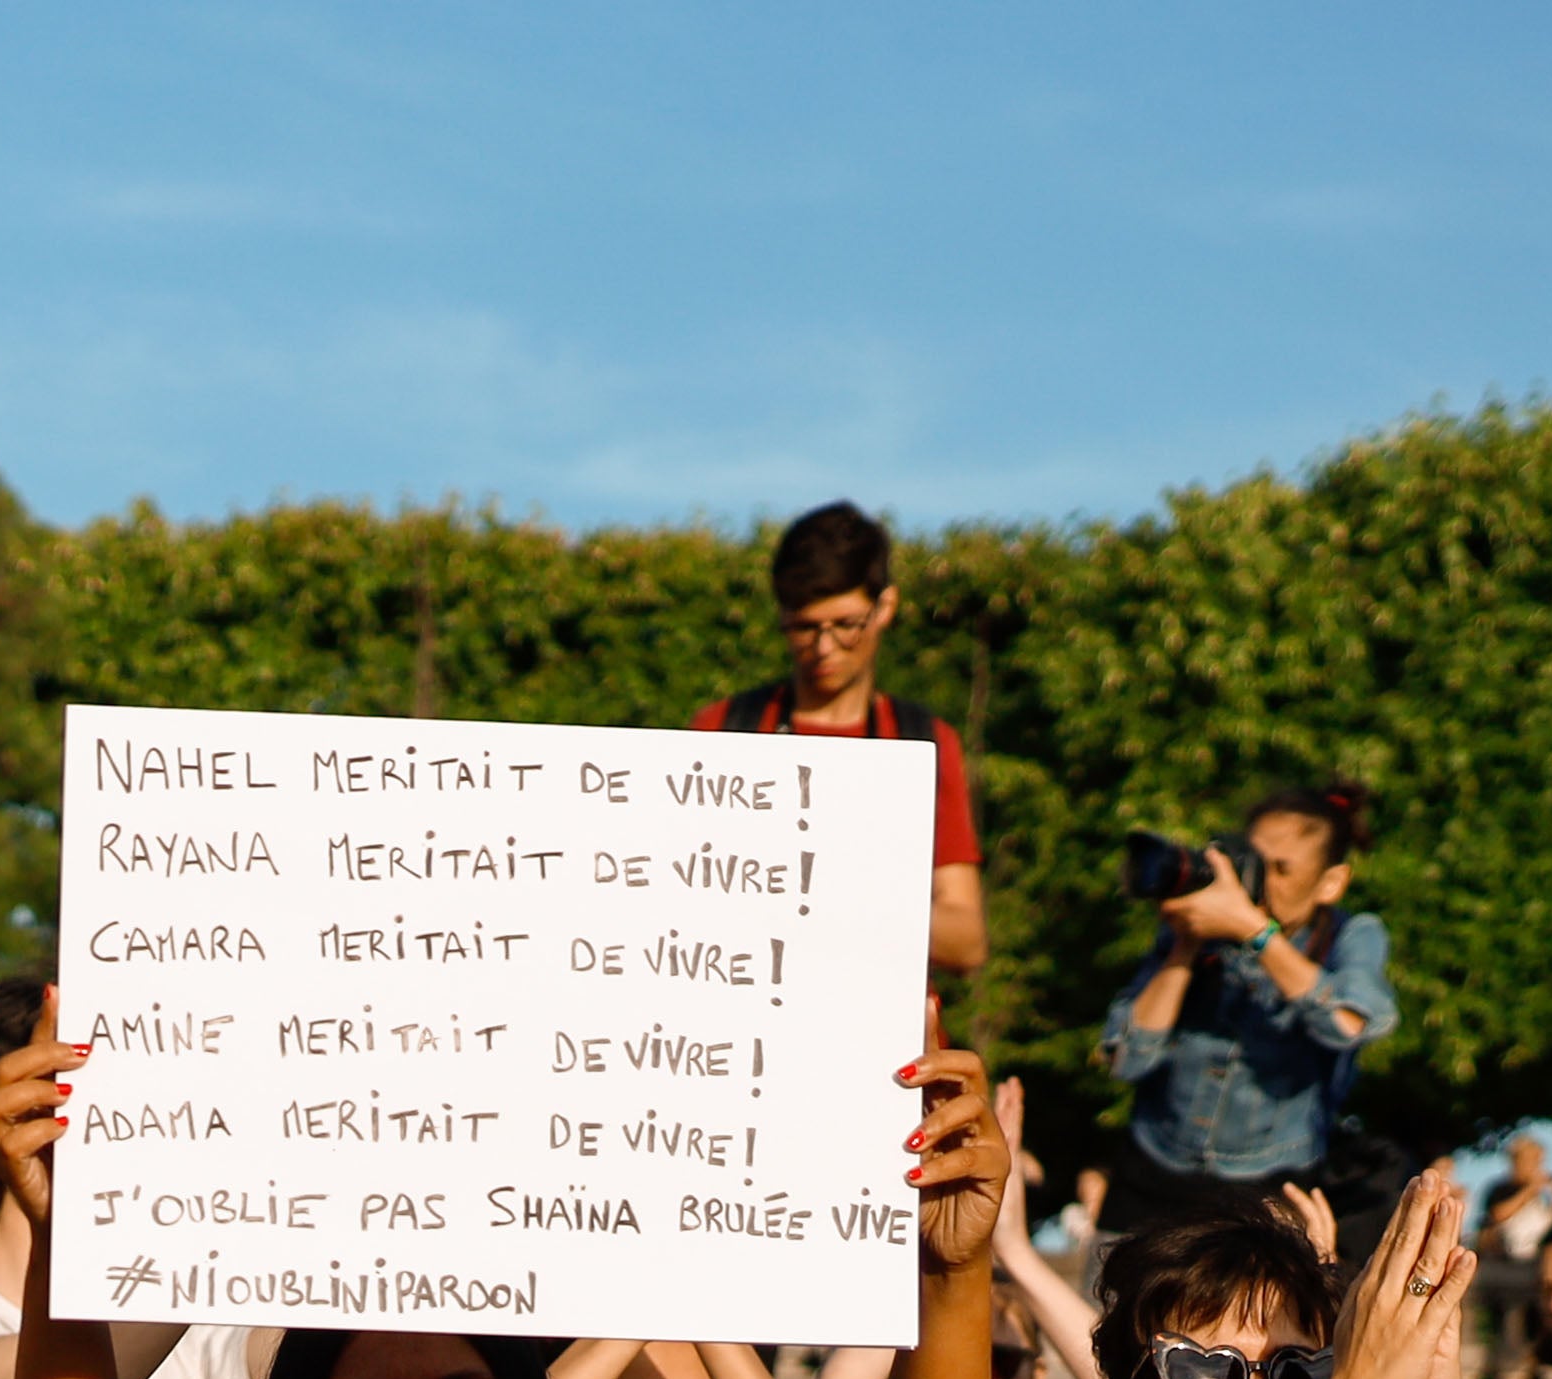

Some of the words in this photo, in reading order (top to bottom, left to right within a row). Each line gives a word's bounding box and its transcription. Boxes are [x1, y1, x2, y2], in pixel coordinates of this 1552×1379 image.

[96, 738, 277, 794] NAHEL
[312, 744, 544, 795] MERITAIT
[580, 761, 631, 803] DE
[99, 822, 280, 878] RAYANA
[328, 829, 564, 881] MERITAIT
[594, 851, 652, 888] DE
[89, 920, 266, 963] CAMARA
[319, 914, 530, 964] MERITAIT
[570, 937, 625, 976] DE
[88, 1002, 235, 1056] AMINE
[278, 1004, 507, 1058] MERITAIT
[551, 1030, 611, 1073] DE
[83, 1100, 231, 1145] ADAMA
[282, 1090, 499, 1144] MERITAIT
[548, 1113, 603, 1157] DE
[92, 1179, 330, 1230] J'OUBLIE
[360, 1193, 447, 1231] PAS
[678, 1191, 813, 1241] BRULÉE
[831, 1186, 914, 1246] VIVE
